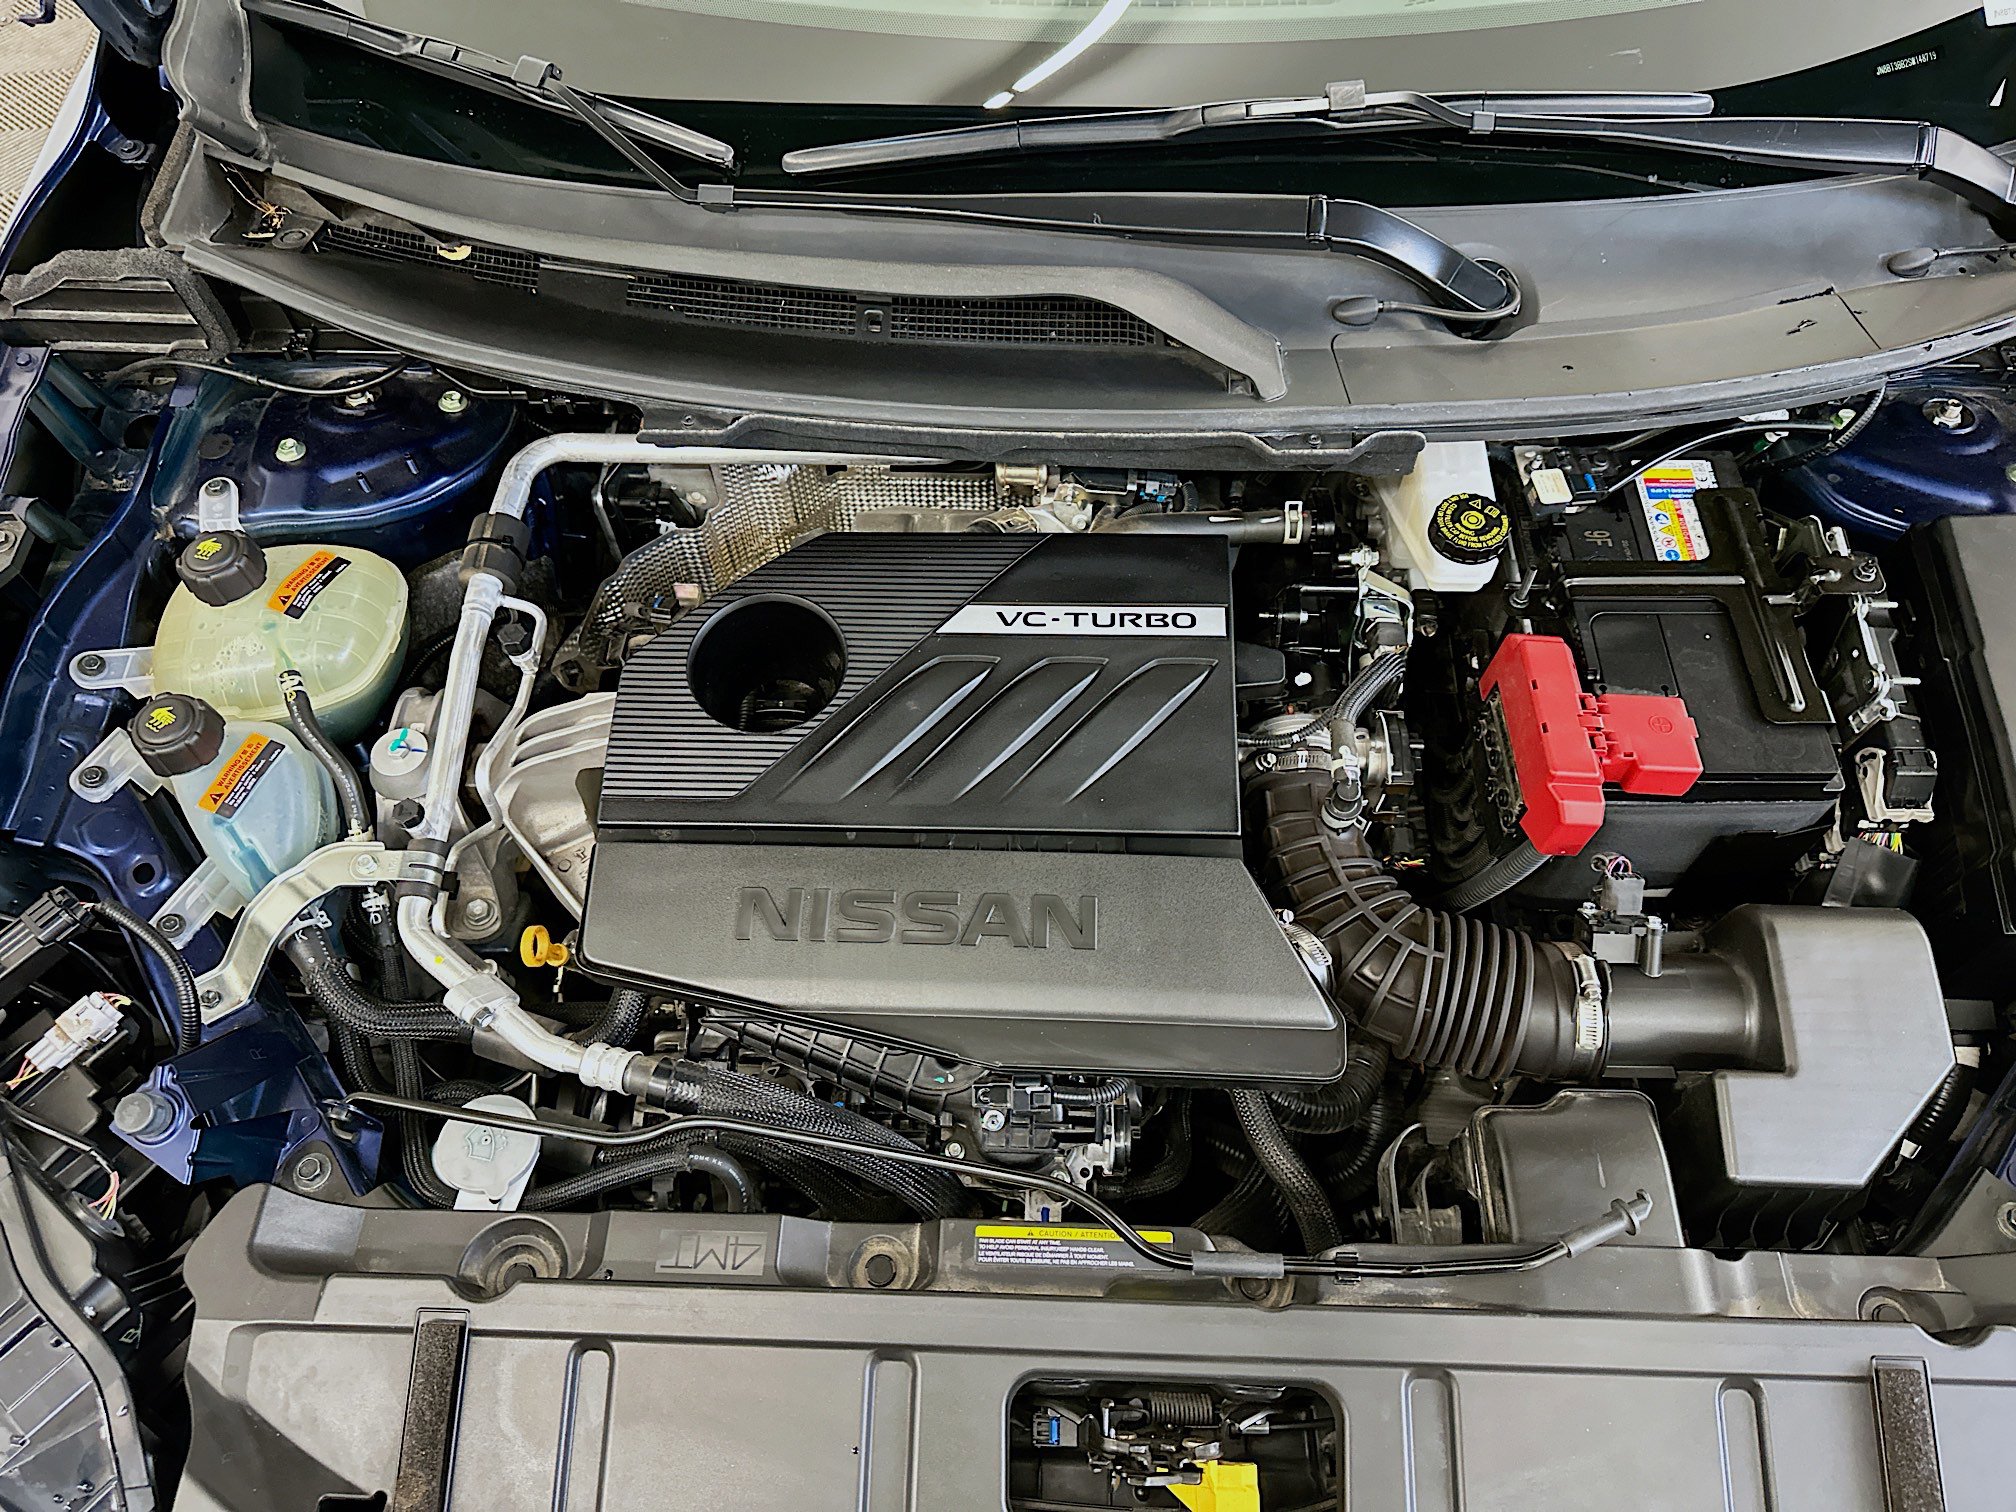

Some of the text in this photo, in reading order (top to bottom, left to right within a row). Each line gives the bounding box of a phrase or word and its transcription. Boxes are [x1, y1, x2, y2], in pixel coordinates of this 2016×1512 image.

[284, 569, 308, 589] WARNING
[291, 557, 330, 592] AVERTISSEMENT
[995, 610, 1198, 630] VC-TURBO
[217, 759, 240, 787] WARNING
[224, 743, 262, 790] AVERTISSEMENT
[735, 885, 1099, 951] NISSAN
